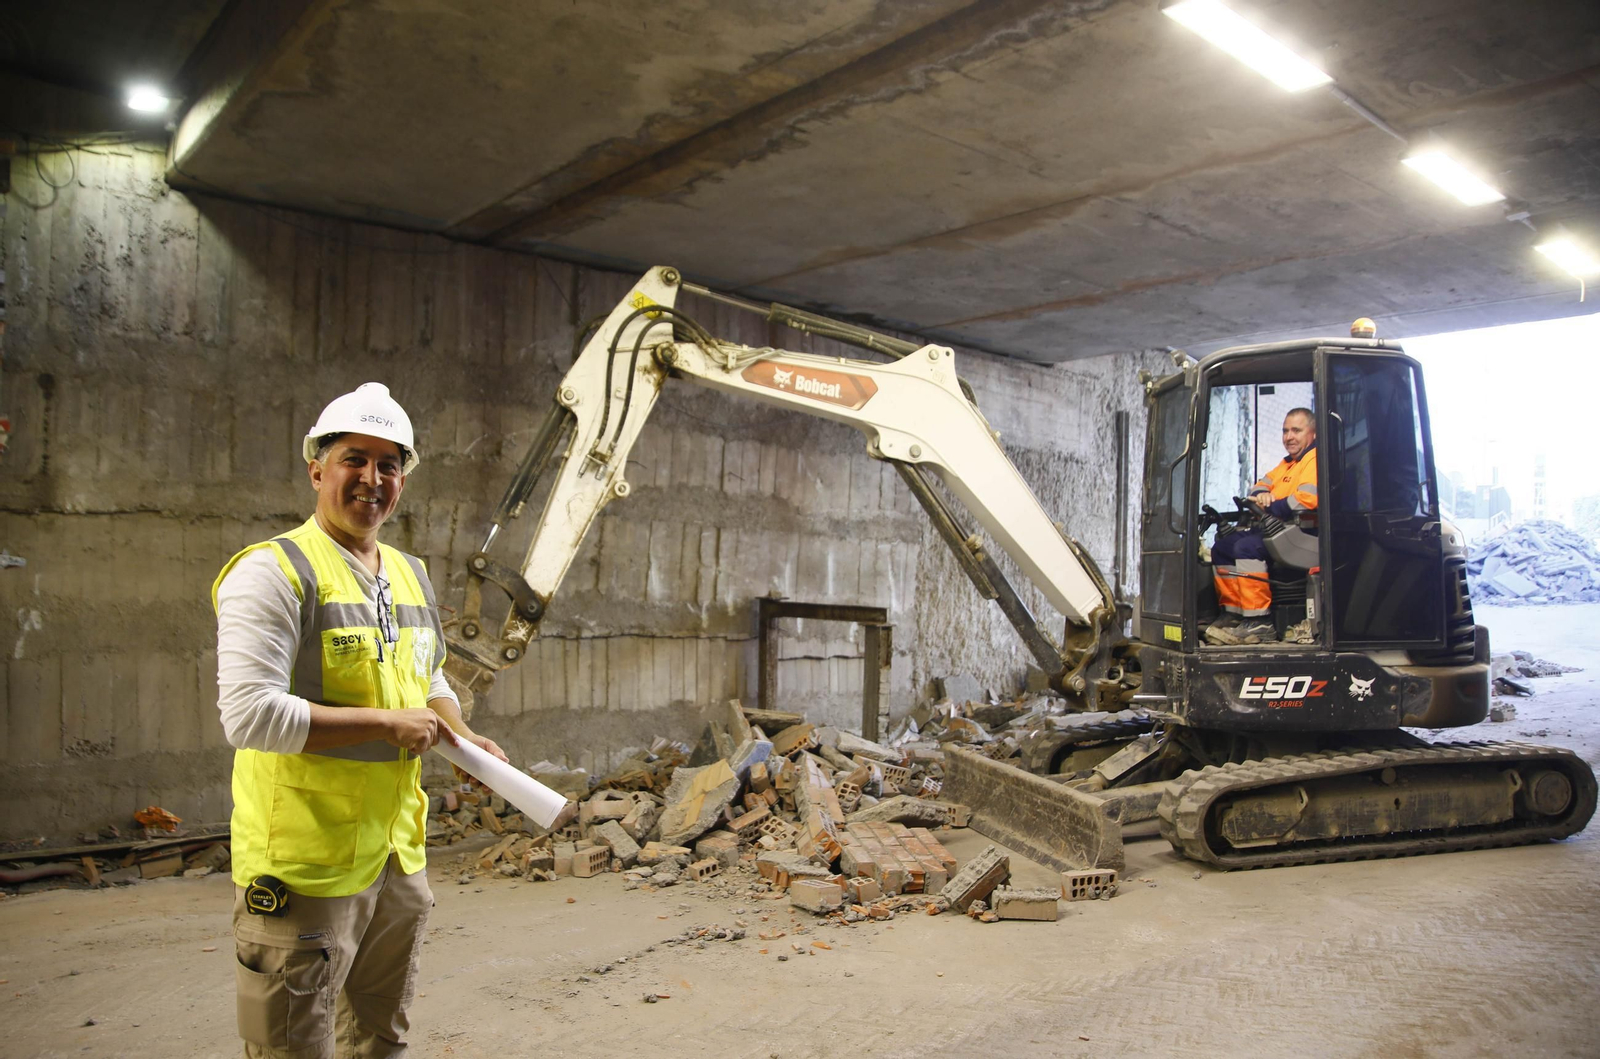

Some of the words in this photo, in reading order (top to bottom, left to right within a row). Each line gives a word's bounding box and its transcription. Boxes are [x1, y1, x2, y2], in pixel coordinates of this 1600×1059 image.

[795, 374, 841, 398] Bobcat
[360, 414, 395, 428] sacyr
[332, 634, 366, 646] sacyr
[1268, 700, 1304, 708] R2-SERIES
